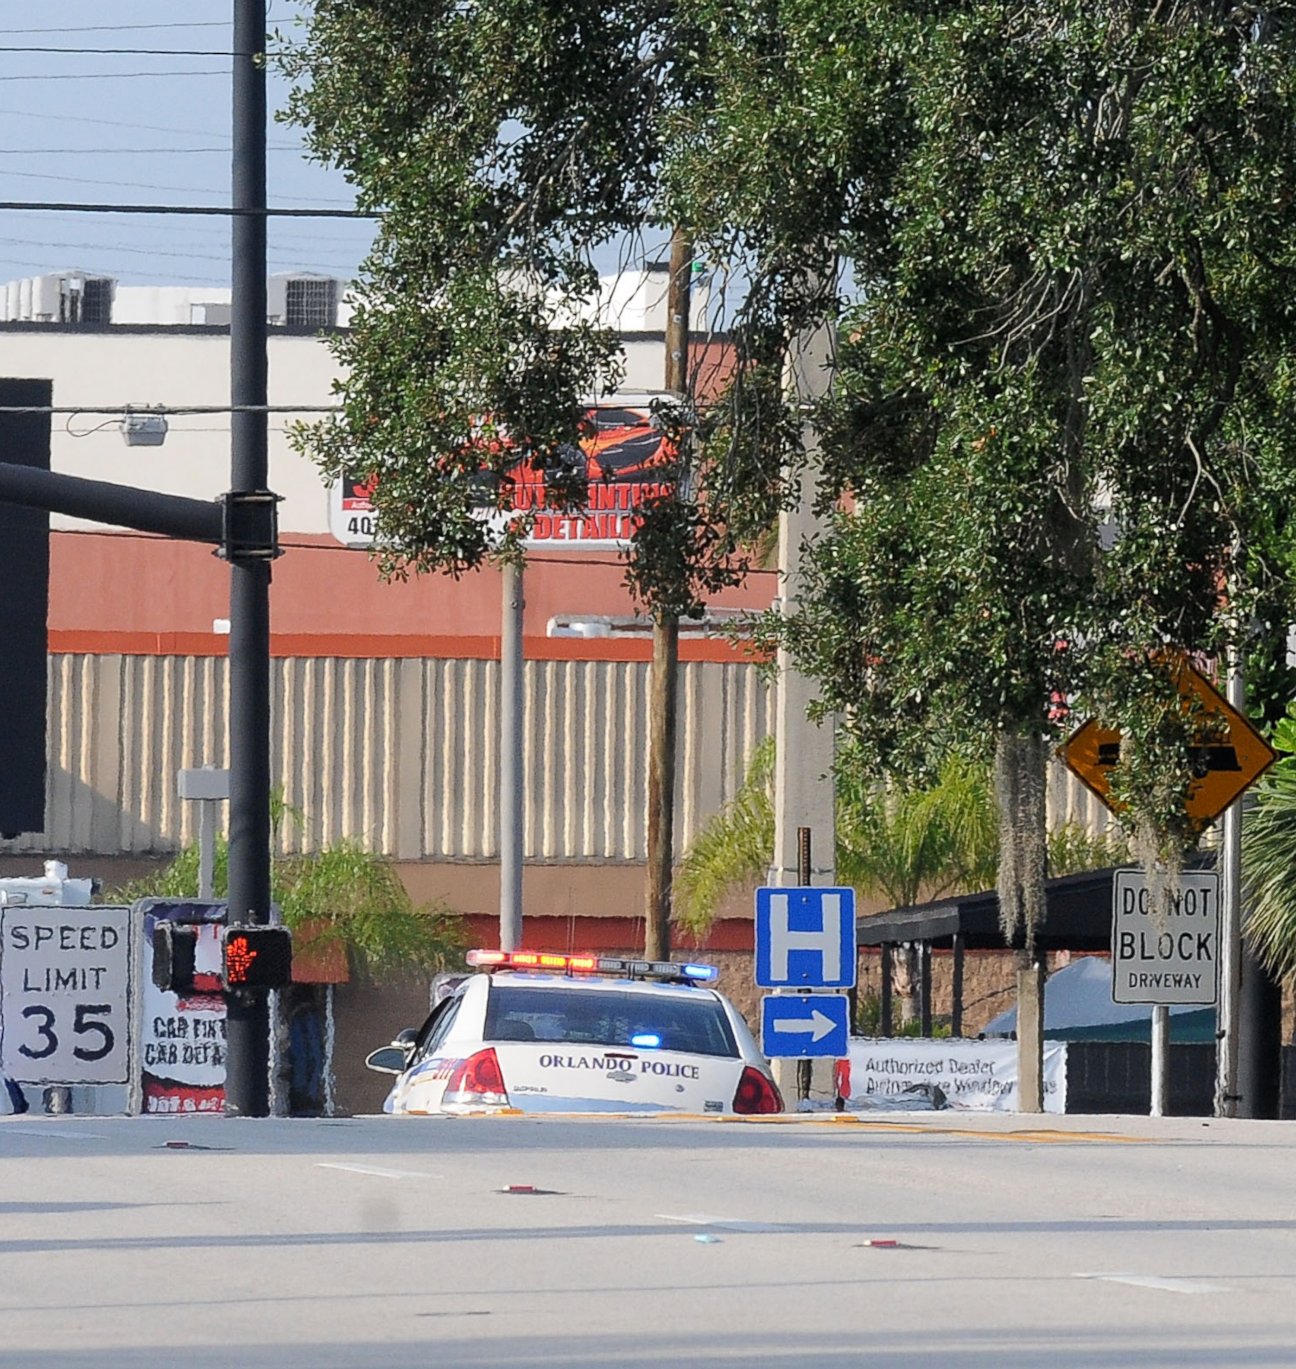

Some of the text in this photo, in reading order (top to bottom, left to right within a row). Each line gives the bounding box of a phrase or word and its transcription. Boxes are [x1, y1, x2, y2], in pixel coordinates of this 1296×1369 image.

[1166, 887, 1212, 917] NOT
[10, 925, 119, 950] SPEED
[769, 894, 841, 982] H
[1120, 932, 1213, 961] BLOCK
[23, 967, 107, 992] LIMIT
[1129, 973, 1202, 989] DRIVEWAY
[18, 1004, 115, 1062] 35
[539, 1055, 700, 1080] ORLANDO POLICE
[866, 1058, 996, 1075] Authorized Dealer
